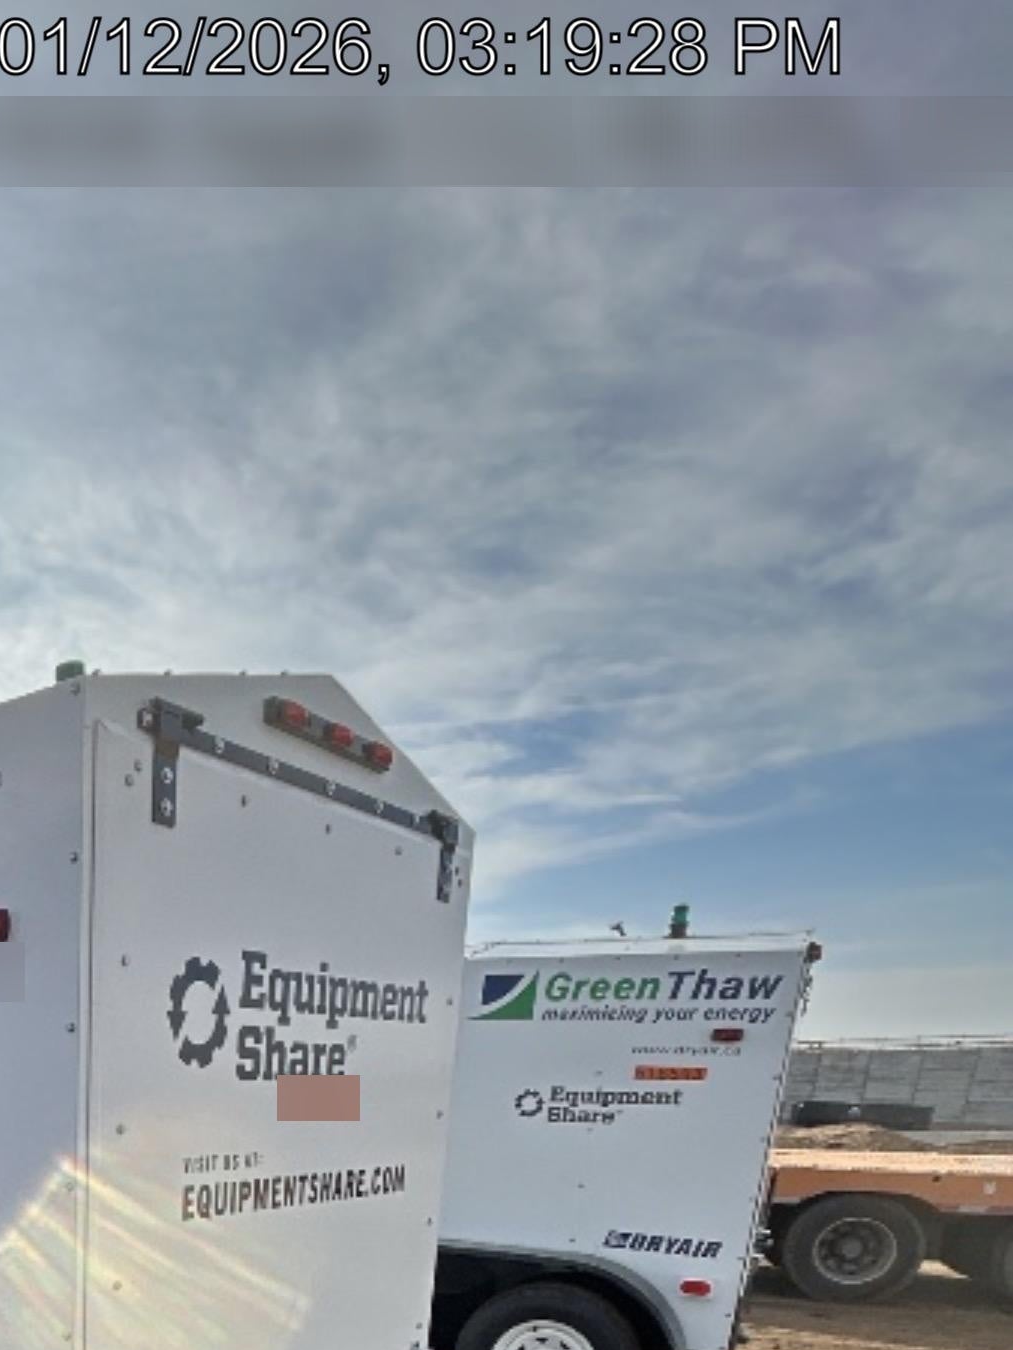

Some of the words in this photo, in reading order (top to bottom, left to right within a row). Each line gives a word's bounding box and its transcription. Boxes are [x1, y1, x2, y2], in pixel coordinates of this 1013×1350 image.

[238, 949, 428, 1029] Equipment
[651, 1008, 698, 1024] your
[704, 1007, 777, 1024] energy
[550, 1085, 683, 1107] Equipment
[181, 1164, 406, 1222] EQUIPMENTSHARE.COM
[628, 1232, 724, 1259] DRYAIR
